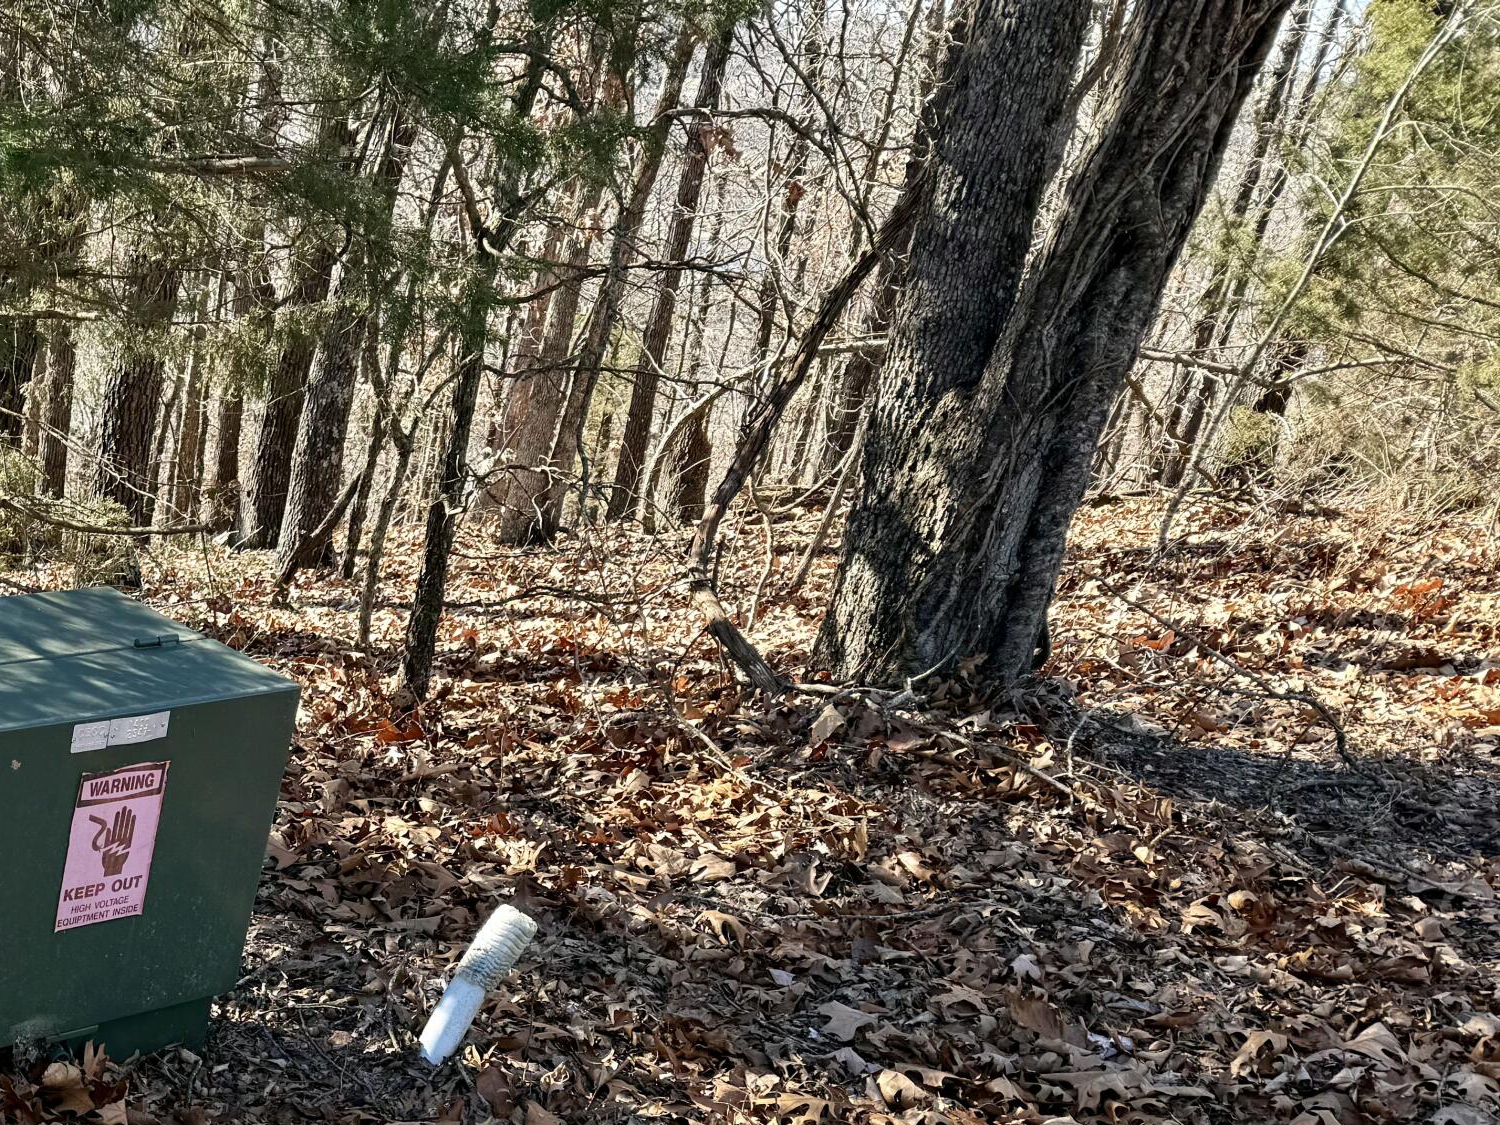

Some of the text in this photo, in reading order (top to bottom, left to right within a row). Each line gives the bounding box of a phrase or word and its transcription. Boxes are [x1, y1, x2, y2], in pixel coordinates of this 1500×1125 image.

[89, 772, 155, 800] WARNING
[63, 875, 143, 902] KEEP OUT
[56, 903, 139, 928] EQUIPTMENT INSIDE
[71, 895, 130, 915] HIGH VOLTAGE
